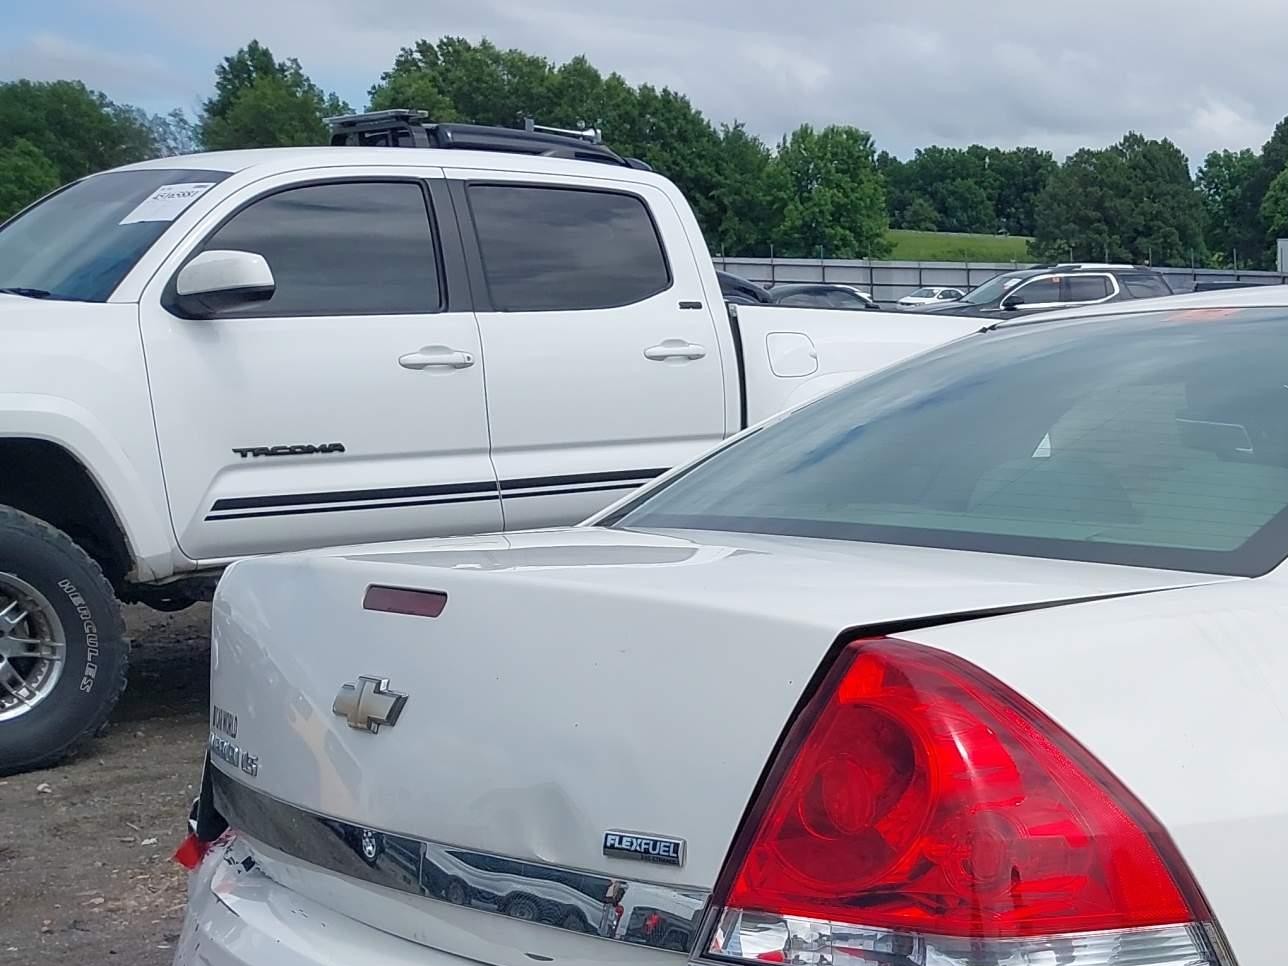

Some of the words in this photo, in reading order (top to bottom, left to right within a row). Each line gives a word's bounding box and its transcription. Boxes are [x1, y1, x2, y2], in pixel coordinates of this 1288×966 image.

[231, 442, 345, 458] TACOMA
[58, 579, 99, 693] HERCULES
[606, 834, 678, 857] FLEXFUEL
